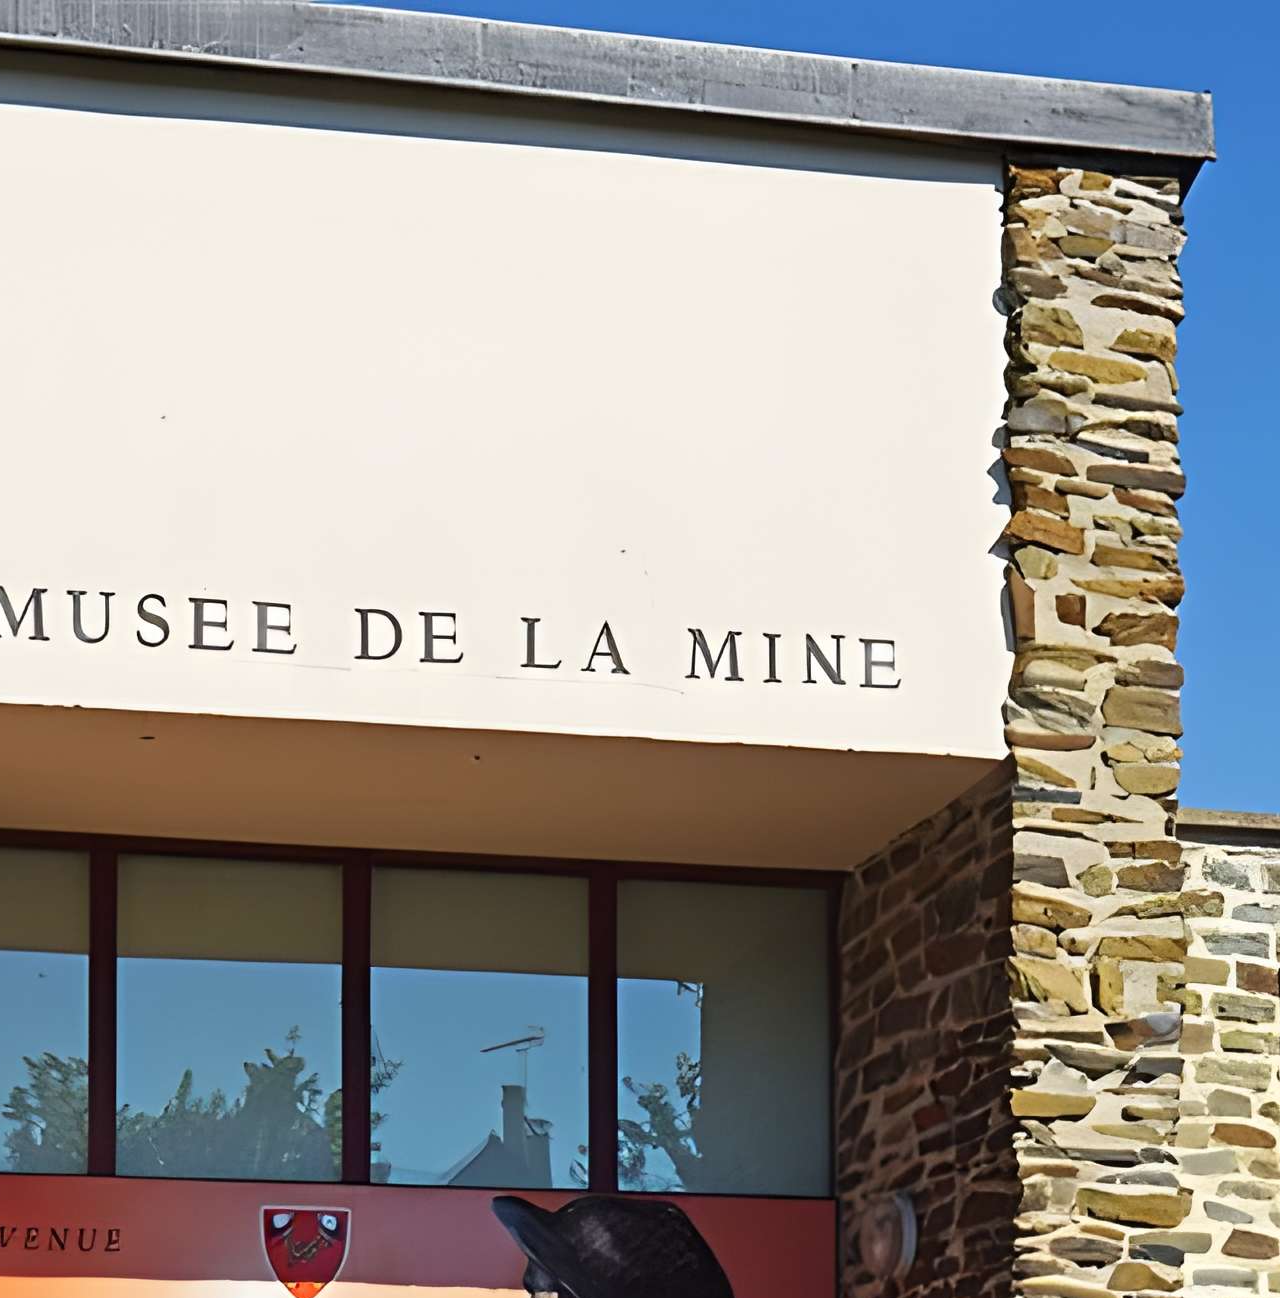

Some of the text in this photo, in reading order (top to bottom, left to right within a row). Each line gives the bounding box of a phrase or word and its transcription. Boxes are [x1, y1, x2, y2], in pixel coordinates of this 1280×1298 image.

[353, 608, 464, 664] DE
[520, 616, 631, 675] LA
[684, 627, 902, 689] MINE
